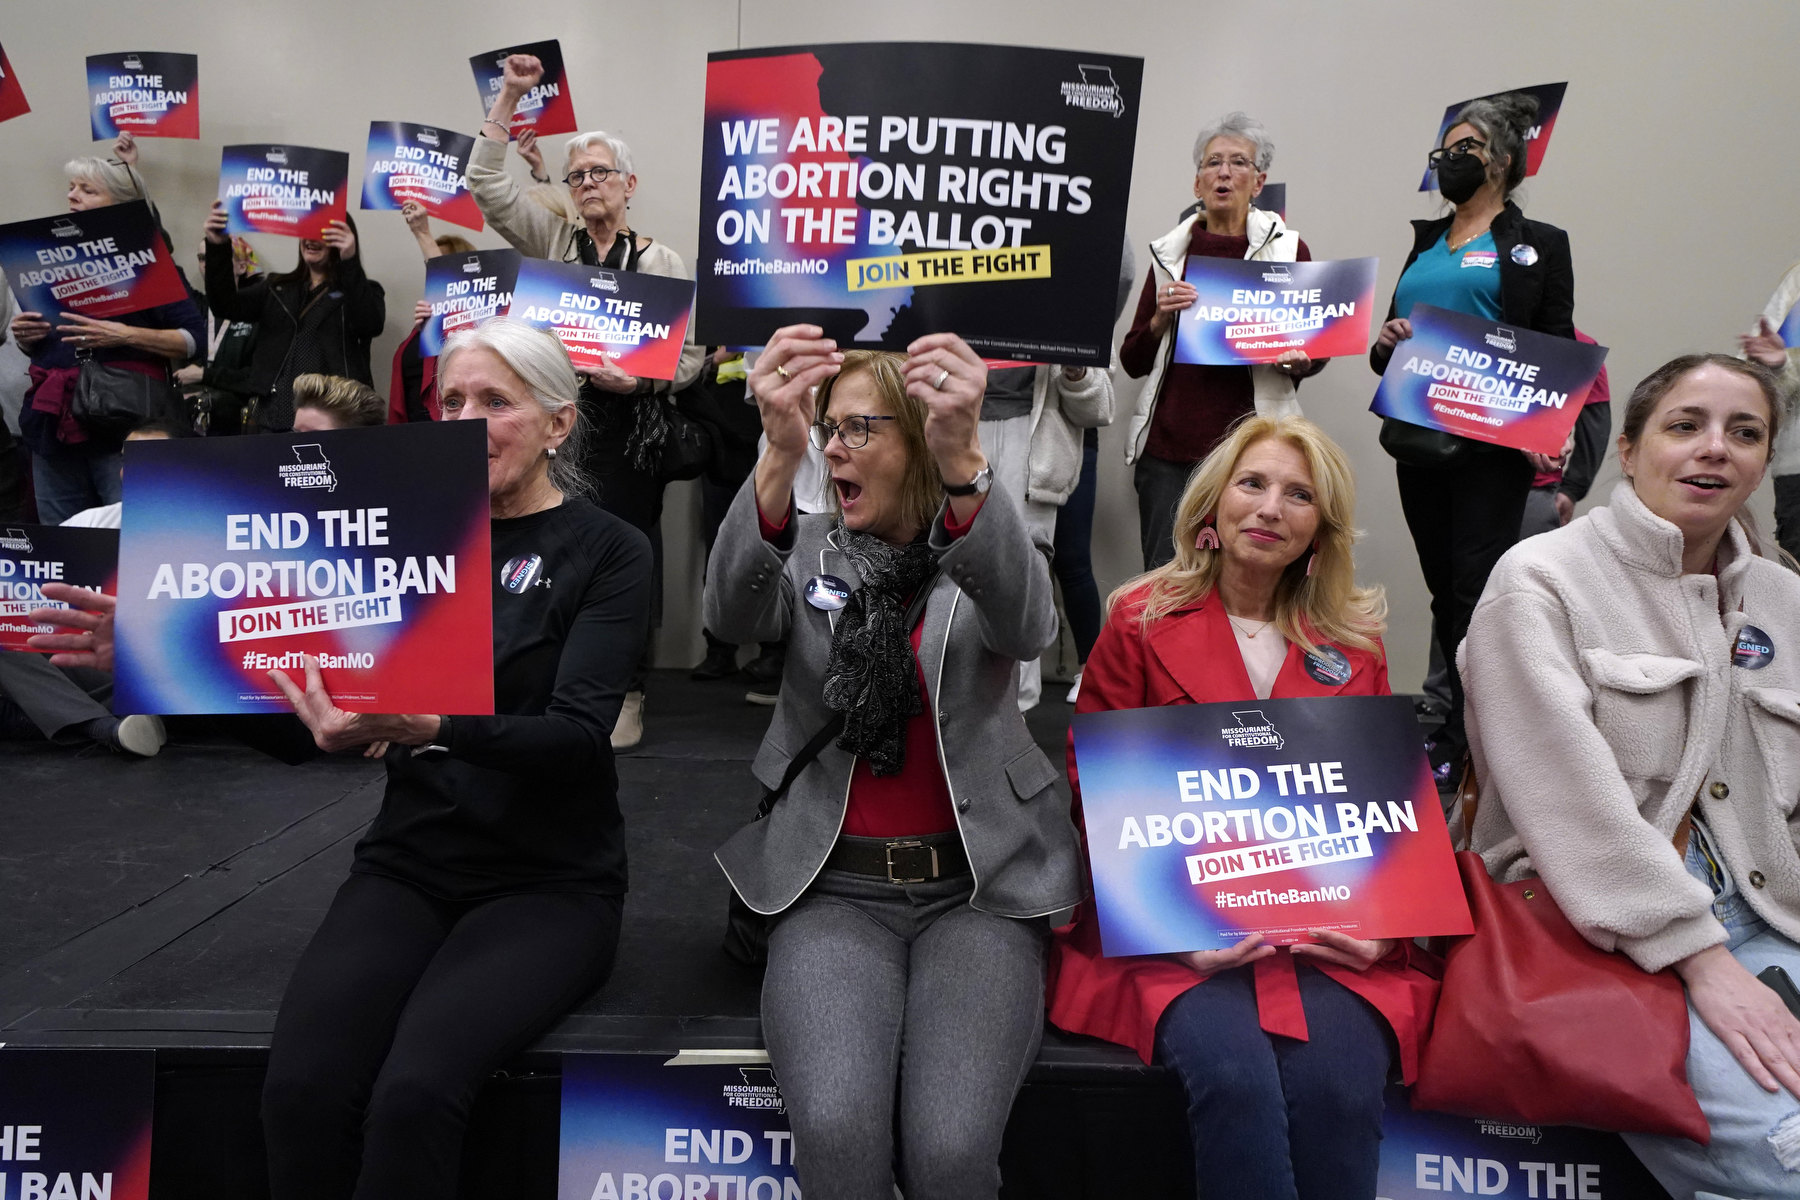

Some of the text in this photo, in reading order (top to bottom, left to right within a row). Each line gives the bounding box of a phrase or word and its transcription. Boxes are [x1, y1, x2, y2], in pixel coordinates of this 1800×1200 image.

[109, 74, 163, 89] END THE
[489, 76, 504, 91] EN
[531, 83, 560, 98] BAN
[95, 90, 187, 106] ABORTION BAN
[1066, 94, 1119, 110] FREEDOM
[721, 116, 1067, 164] WE ARE PUTTING
[394, 146, 460, 170] END THE
[246, 168, 309, 186] END THE
[372, 160, 468, 190] ABORTION BA
[392, 178, 453, 191] JOIN THE FIGHT
[226, 184, 334, 206] ABORTION BAN
[717, 162, 1092, 215] ABORTION RIGHTS
[716, 208, 1032, 250] ON THE BALLOT
[36, 237, 119, 266] END THE
[19, 248, 157, 289] ABORTION BAN
[714, 258, 829, 276] #EndTheBanMO
[857, 252, 1041, 288] JOIN THE FIGHT
[56, 269, 130, 297] JOIN THE FIGHT
[446, 276, 498, 297] END THE
[68, 290, 129, 308] #EndTheBanMO
[431, 294, 486, 317] ABORTION
[559, 292, 643, 318] END THE
[1232, 288, 1322, 305] END THE
[460, 312, 472, 320] THE
[522, 306, 670, 340] ABORTION BAN
[1194, 302, 1356, 322] ABORTION BAN
[556, 330, 636, 342] OIN THE FIGHT
[1230, 320, 1318, 337] JOIN THE FIGHT
[1235, 338, 1306, 350] #EndTheBanMO
[1445, 344, 1540, 383] END THE
[1402, 356, 1568, 410] ABORTION BAN
[1432, 386, 1526, 410] JOIN THE FIGHT
[1433, 402, 1504, 427] #EndTheBanMO
[279, 462, 326, 472] MISSOURIANS
[284, 475, 332, 487] FREEDOM
[226, 508, 389, 551] END THE
[2, 542, 30, 550] FREEDOM
[20, 560, 64, 580] THE
[146, 554, 456, 600] ABORTION BAN
[510, 562, 534, 588] SIGNED
[4, 604, 26, 613] THE
[230, 596, 392, 640] JOIN THE FIGHT
[1738, 642, 1770, 654] GNED
[1222, 726, 1270, 734] MISSOURIANS
[1228, 736, 1278, 746] FREEDOM
[1177, 761, 1348, 802] END THE
[1118, 800, 1418, 850] ABORTION BAN
[1197, 835, 1360, 882] JOIN THE FIGHT
[1215, 885, 1350, 908] #EndTheBanMO
[723, 1085, 778, 1093] MISSOURIANS
[729, 1096, 782, 1107] FREEDOM
[1481, 1124, 1536, 1137] FREEDOM
[664, 1128, 754, 1164] END
[20, 1172, 112, 1200] BAN
[590, 1172, 802, 1200] ABORTION
[1416, 1153, 1602, 1200] END THE
